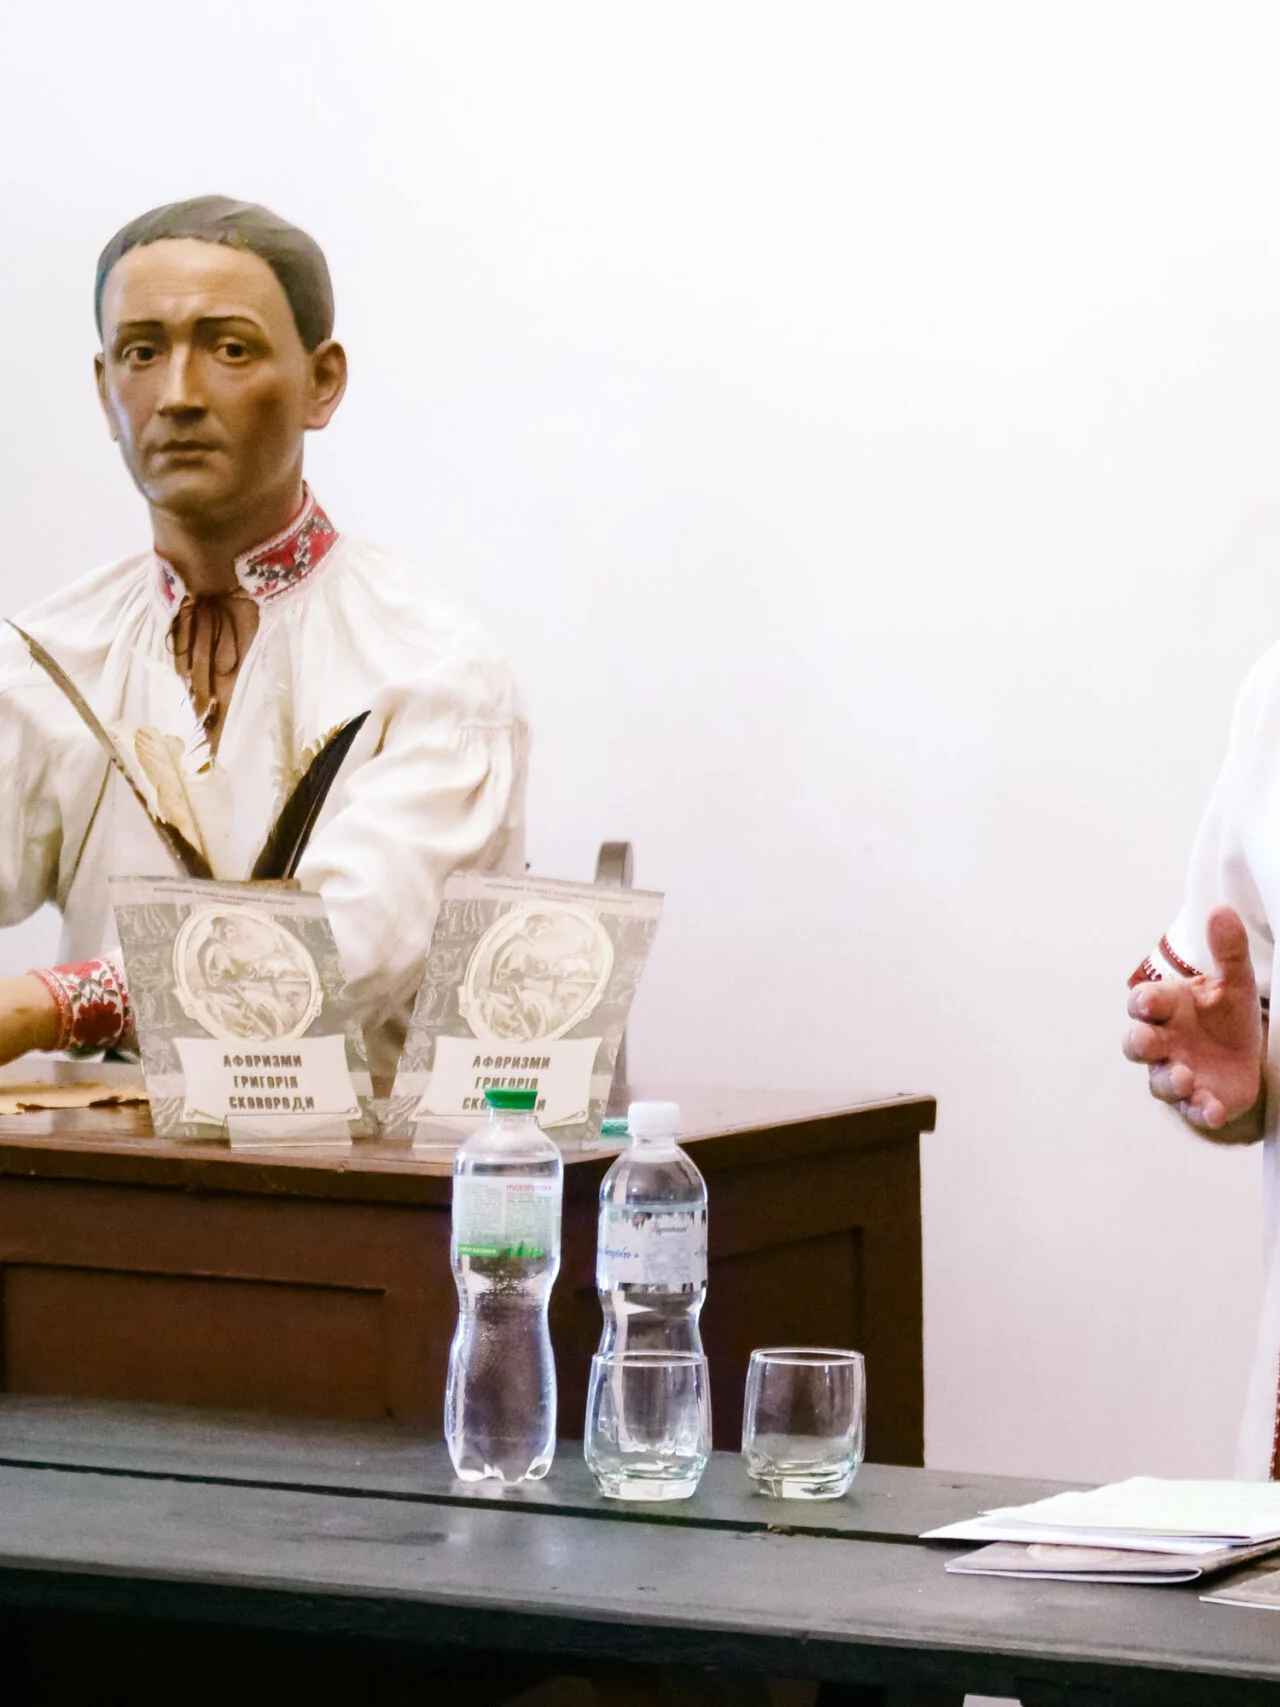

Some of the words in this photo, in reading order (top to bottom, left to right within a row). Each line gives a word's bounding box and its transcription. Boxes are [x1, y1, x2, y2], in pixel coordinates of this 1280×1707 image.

[223, 1054, 303, 1068] АФОРИЗМИ
[471, 1055, 551, 1070] АФОРИЗМИ
[232, 1075, 299, 1089] ГРИГОРІЯ
[474, 1076, 539, 1090] ГРИГОРІЯ
[228, 1096, 315, 1112] СКОВОРОДИ
